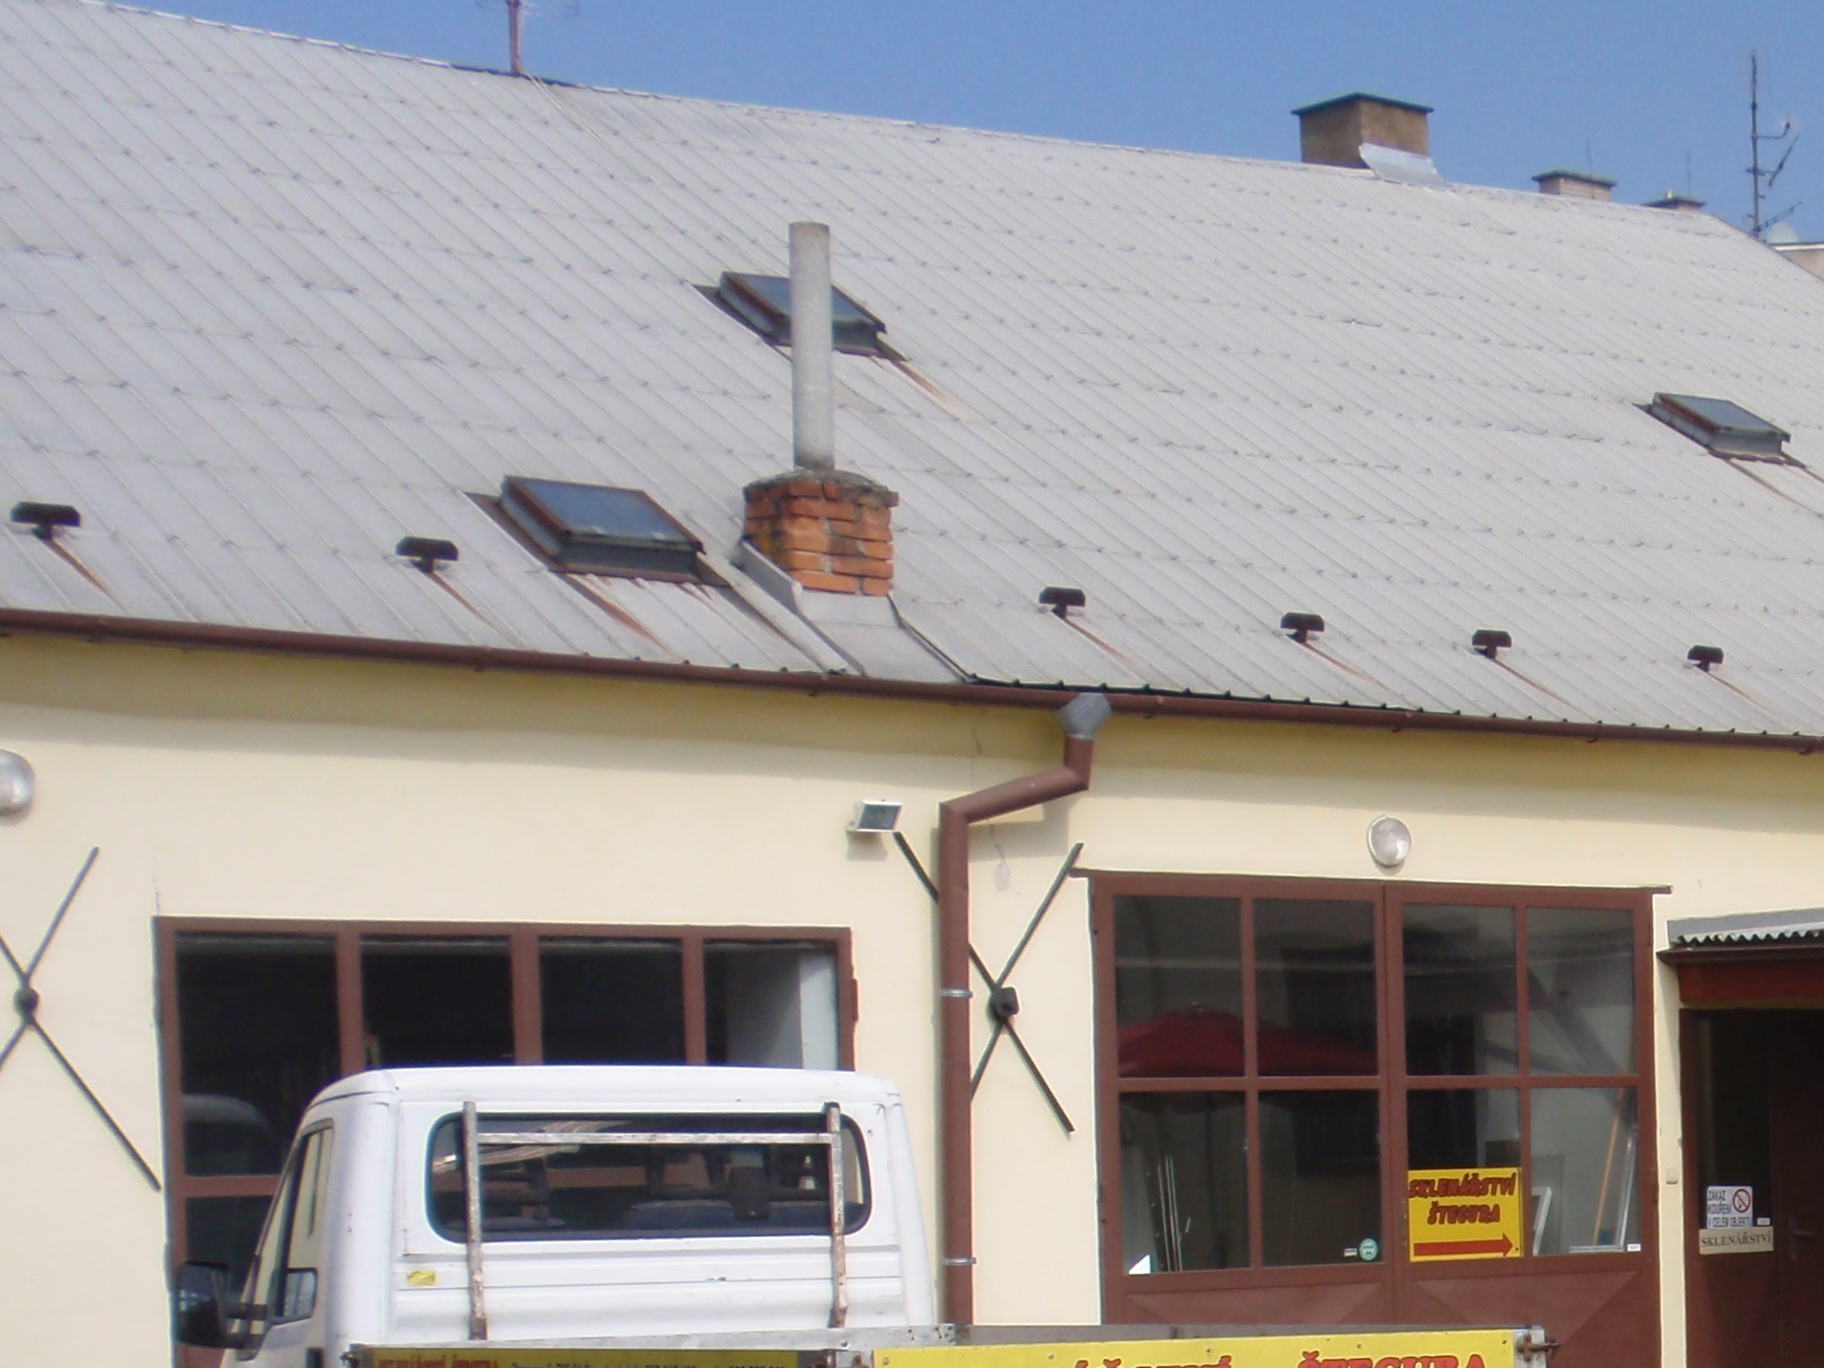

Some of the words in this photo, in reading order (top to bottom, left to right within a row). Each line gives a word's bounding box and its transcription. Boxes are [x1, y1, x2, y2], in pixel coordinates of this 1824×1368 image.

[1408, 1172, 1516, 1198] SKLENÁŘSTVÍ
[1427, 1200, 1501, 1225] ŠTECURA
[1701, 1231, 1771, 1247] SKLENÁŘSTVÍ
